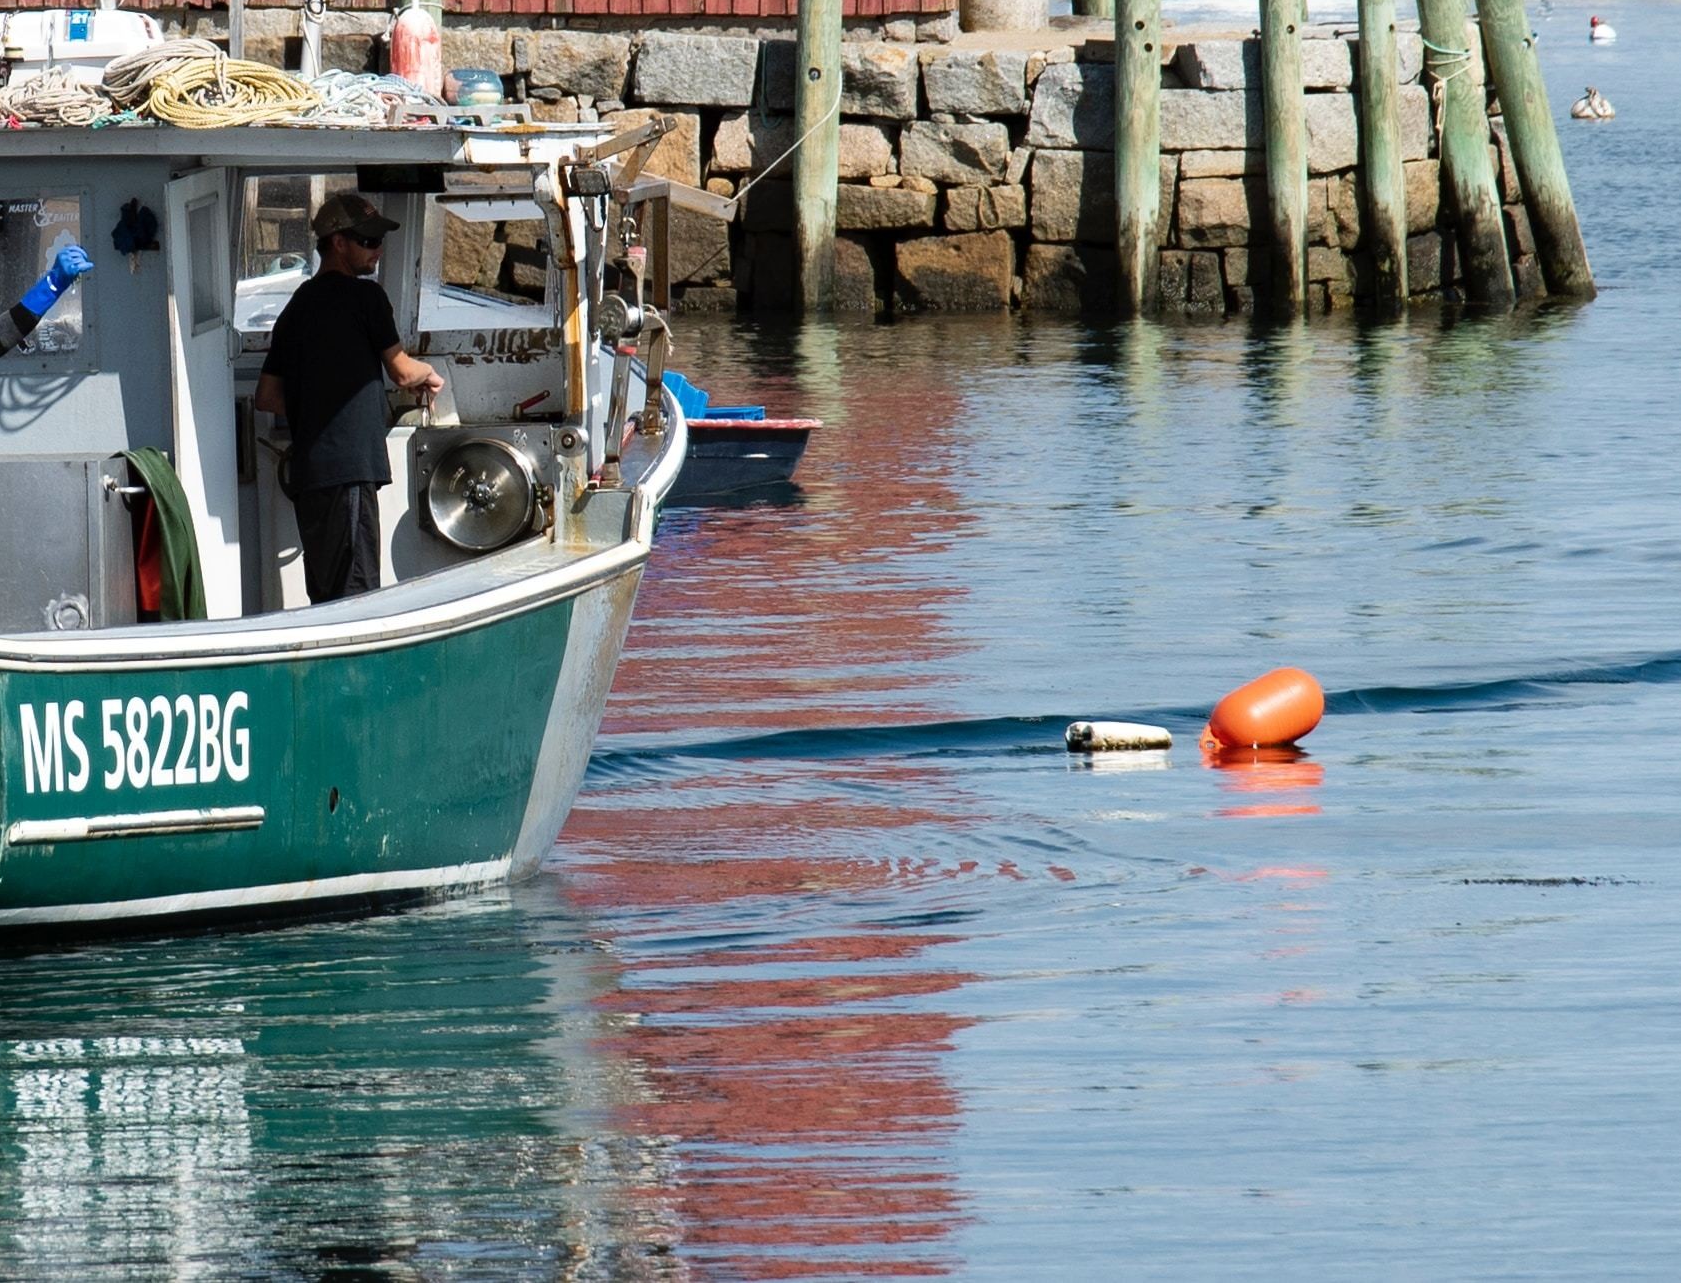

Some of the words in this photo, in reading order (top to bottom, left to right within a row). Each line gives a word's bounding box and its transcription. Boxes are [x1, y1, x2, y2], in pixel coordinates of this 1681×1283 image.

[8, 203, 39, 214] MASTER
[19, 699, 89, 794] MS
[102, 691, 250, 790] 5822BG
